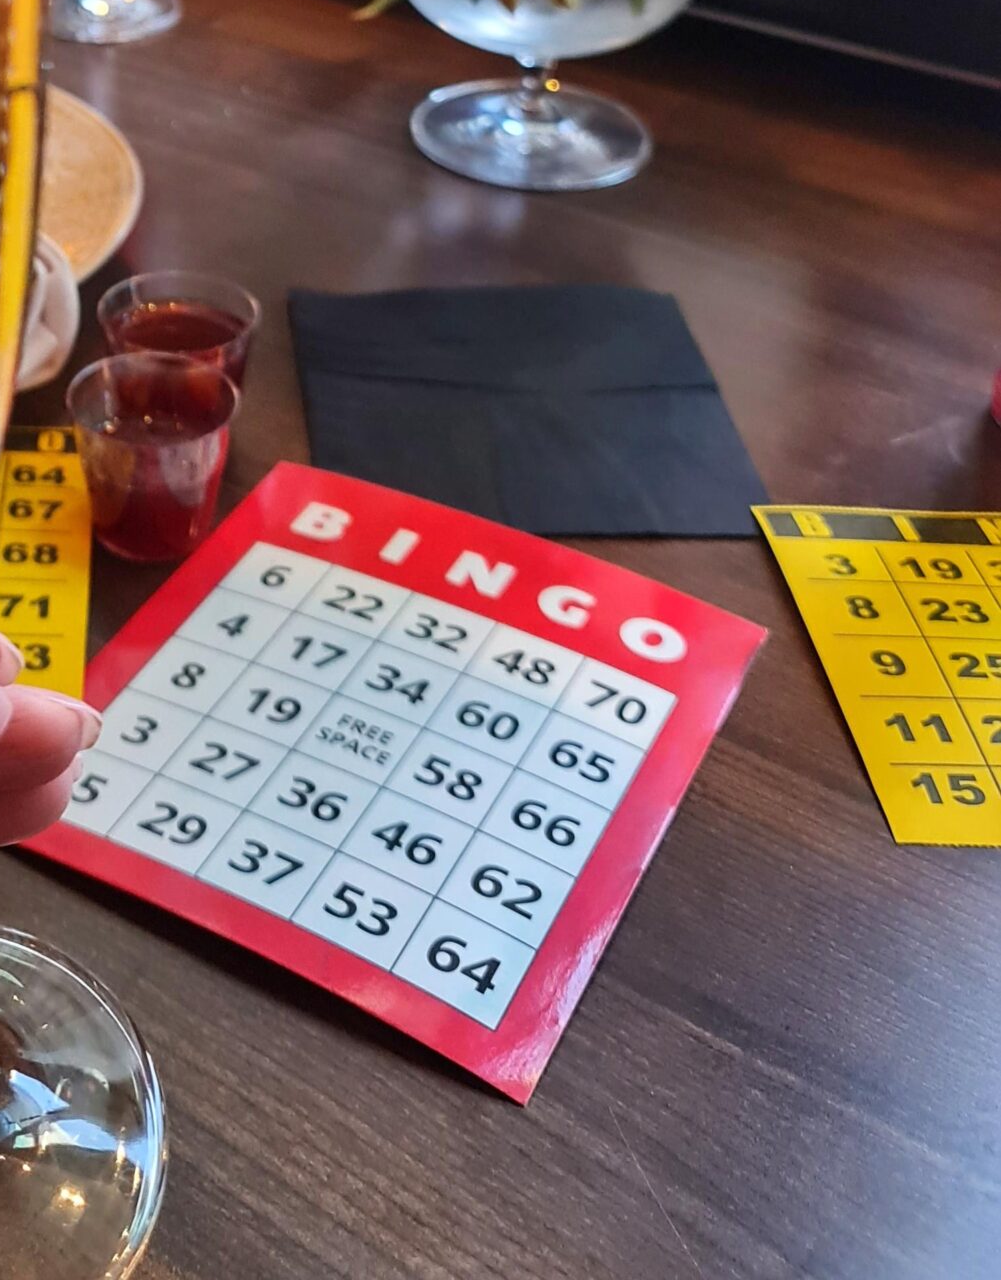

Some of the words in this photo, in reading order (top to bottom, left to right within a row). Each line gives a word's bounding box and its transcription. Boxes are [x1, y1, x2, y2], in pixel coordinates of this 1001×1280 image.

[11, 466, 66, 487] 64
[8, 500, 63, 521] 67
[2, 543, 59, 565] 68
[824, 554, 858, 576] 3
[900, 557, 963, 580] 19
[290, 501, 688, 663] BINGO
[847, 596, 880, 620] 8
[920, 598, 990, 624] 23
[260, 566, 291, 588] 6
[323, 586, 384, 622] 22
[404, 612, 470, 654] 32
[494, 651, 556, 685] 48
[587, 679, 649, 726] 70
[870, 650, 907, 677] 9
[171, 663, 206, 689] 8
[248, 689, 302, 723] 19
[218, 615, 249, 637] 4
[292, 637, 348, 668] 17
[365, 665, 430, 705] 34
[457, 702, 520, 741] 60
[549, 741, 615, 783] 65
[316, 724, 392, 766] SPACE
[333, 714, 394, 748] FREE
[884, 713, 953, 743] 11
[414, 756, 483, 801] 58
[511, 800, 581, 847] 66
[910, 772, 986, 806] 15
[120, 717, 158, 744] 3
[189, 743, 261, 781] 27
[277, 777, 348, 822] 36
[372, 822, 443, 866] 46
[469, 865, 543, 920] 62
[138, 803, 208, 845] 29
[228, 840, 304, 885] 37
[323, 883, 398, 937] 53
[426, 936, 501, 994] 64
